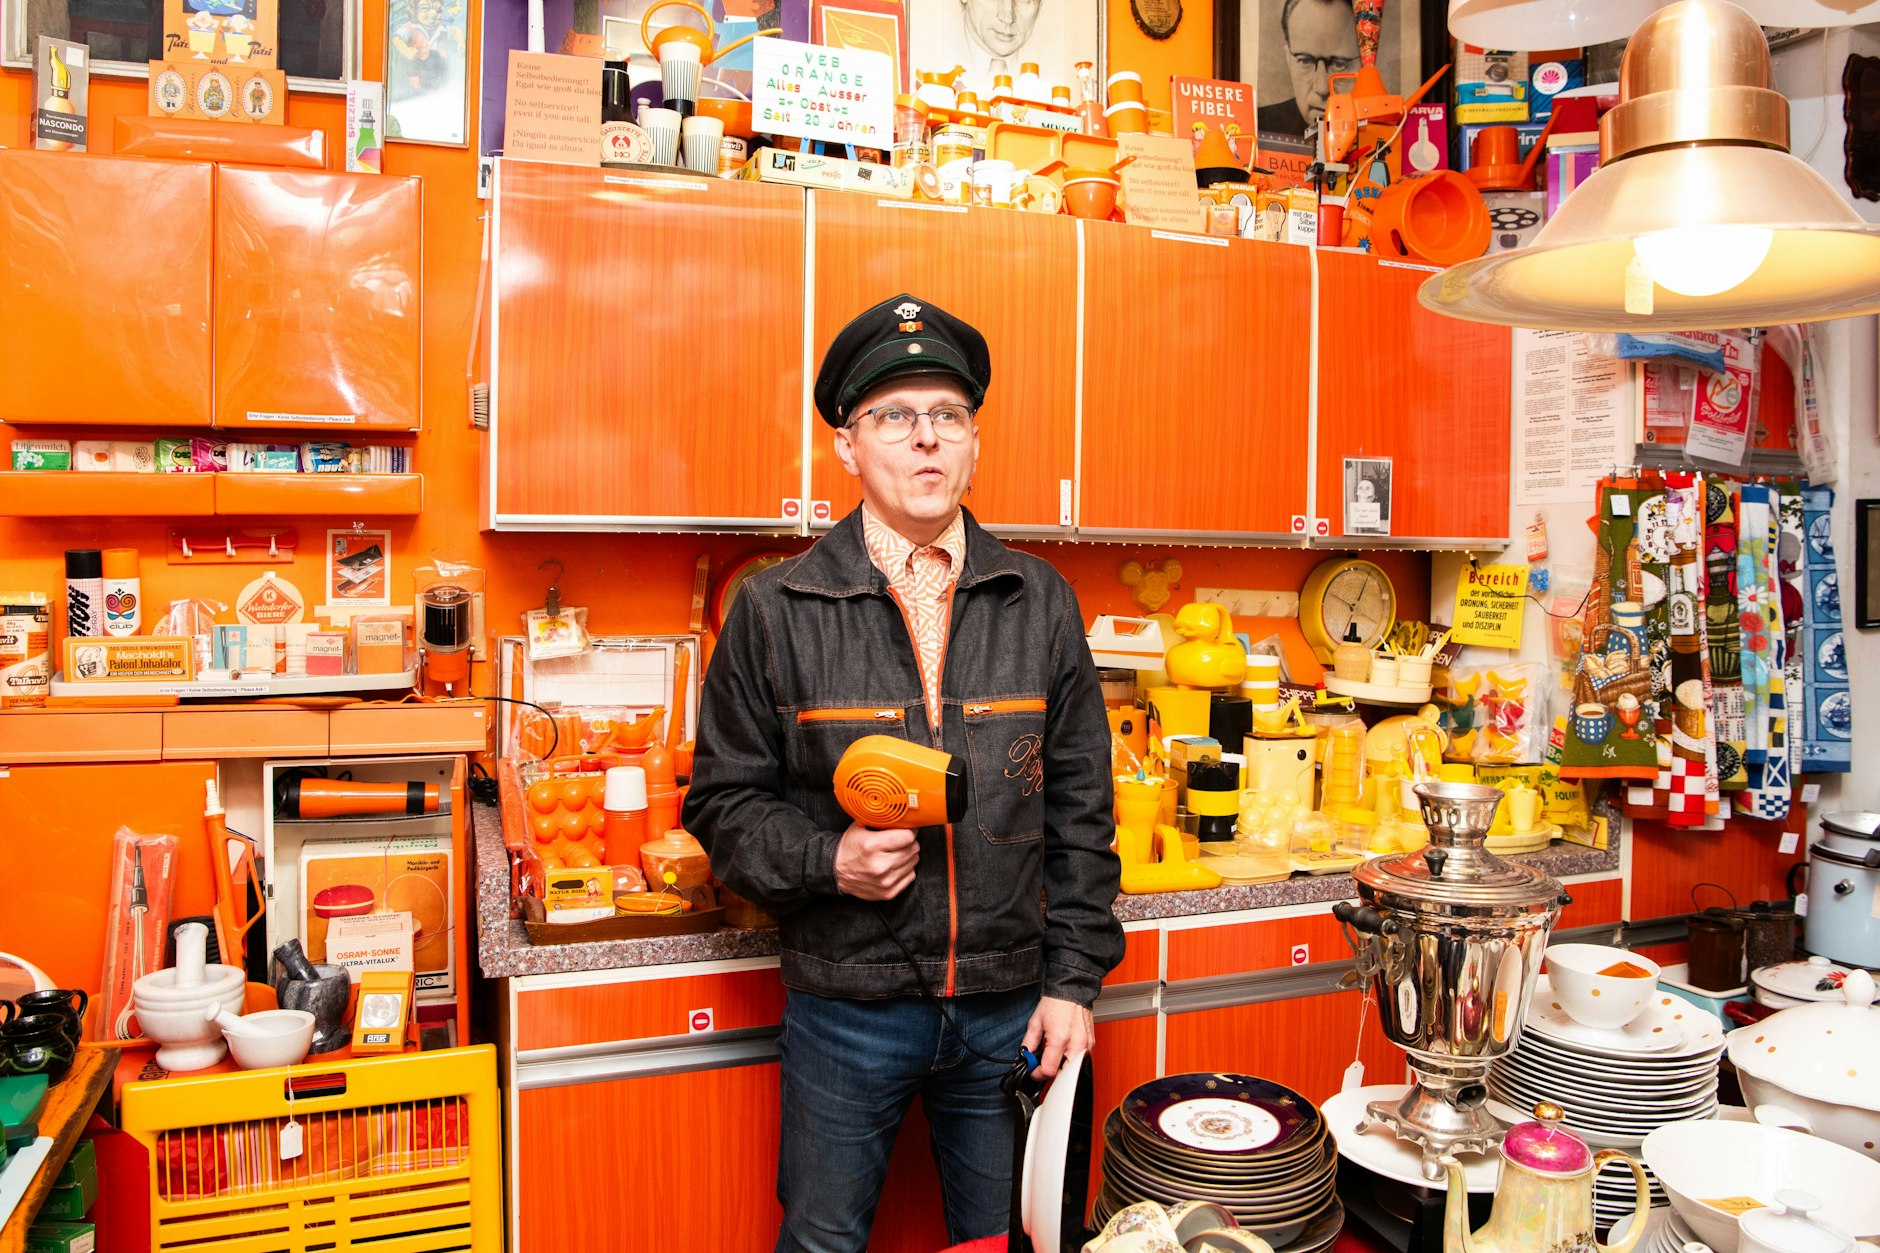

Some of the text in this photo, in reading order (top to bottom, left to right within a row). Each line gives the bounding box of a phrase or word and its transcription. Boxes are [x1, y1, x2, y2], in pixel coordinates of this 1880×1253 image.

[166, 33, 272, 65] Putz und Putzi
[516, 62, 541, 72] Keine
[804, 52, 840, 68] VEB
[515, 71, 590, 86] Selbstbedienung!!
[781, 63, 863, 87] ORANGE
[515, 80, 535, 89] Egal
[536, 82, 551, 90] wie
[553, 84, 572, 94] groß
[574, 86, 585, 95] du
[766, 77, 867, 102] Alles Ausser
[1180, 82, 1244, 102] UNSERE
[514, 98, 580, 112] No selfservice!!
[1191, 100, 1235, 118] FIBEL
[348, 90, 356, 138] SPEZIAL
[513, 110, 592, 124] even if you are tall.
[39, 117, 85, 133] NASCONDO
[763, 108, 876, 135] Seit 20 Jahren
[511, 139, 585, 153] Da igual tu altura.
[1129, 187, 1145, 195] even
[1154, 189, 1166, 197] you
[1293, 190, 1317, 199] NARVA
[1297, 224, 1316, 233] kuppe
[1299, 217, 1316, 226] Silber
[15, 442, 66, 451] Lilienmilch
[1468, 571, 1519, 586] Bereich
[1470, 589, 1480, 597] der
[1460, 598, 1519, 610] ORDNUNG, SICHERHEIT
[1474, 610, 1508, 621] SAUBERKEIT
[1462, 621, 1502, 631] und DISZIPLIN
[1278, 686, 1316, 701] CHIPPE
[336, 947, 401, 960] OSRAM-SONNE
